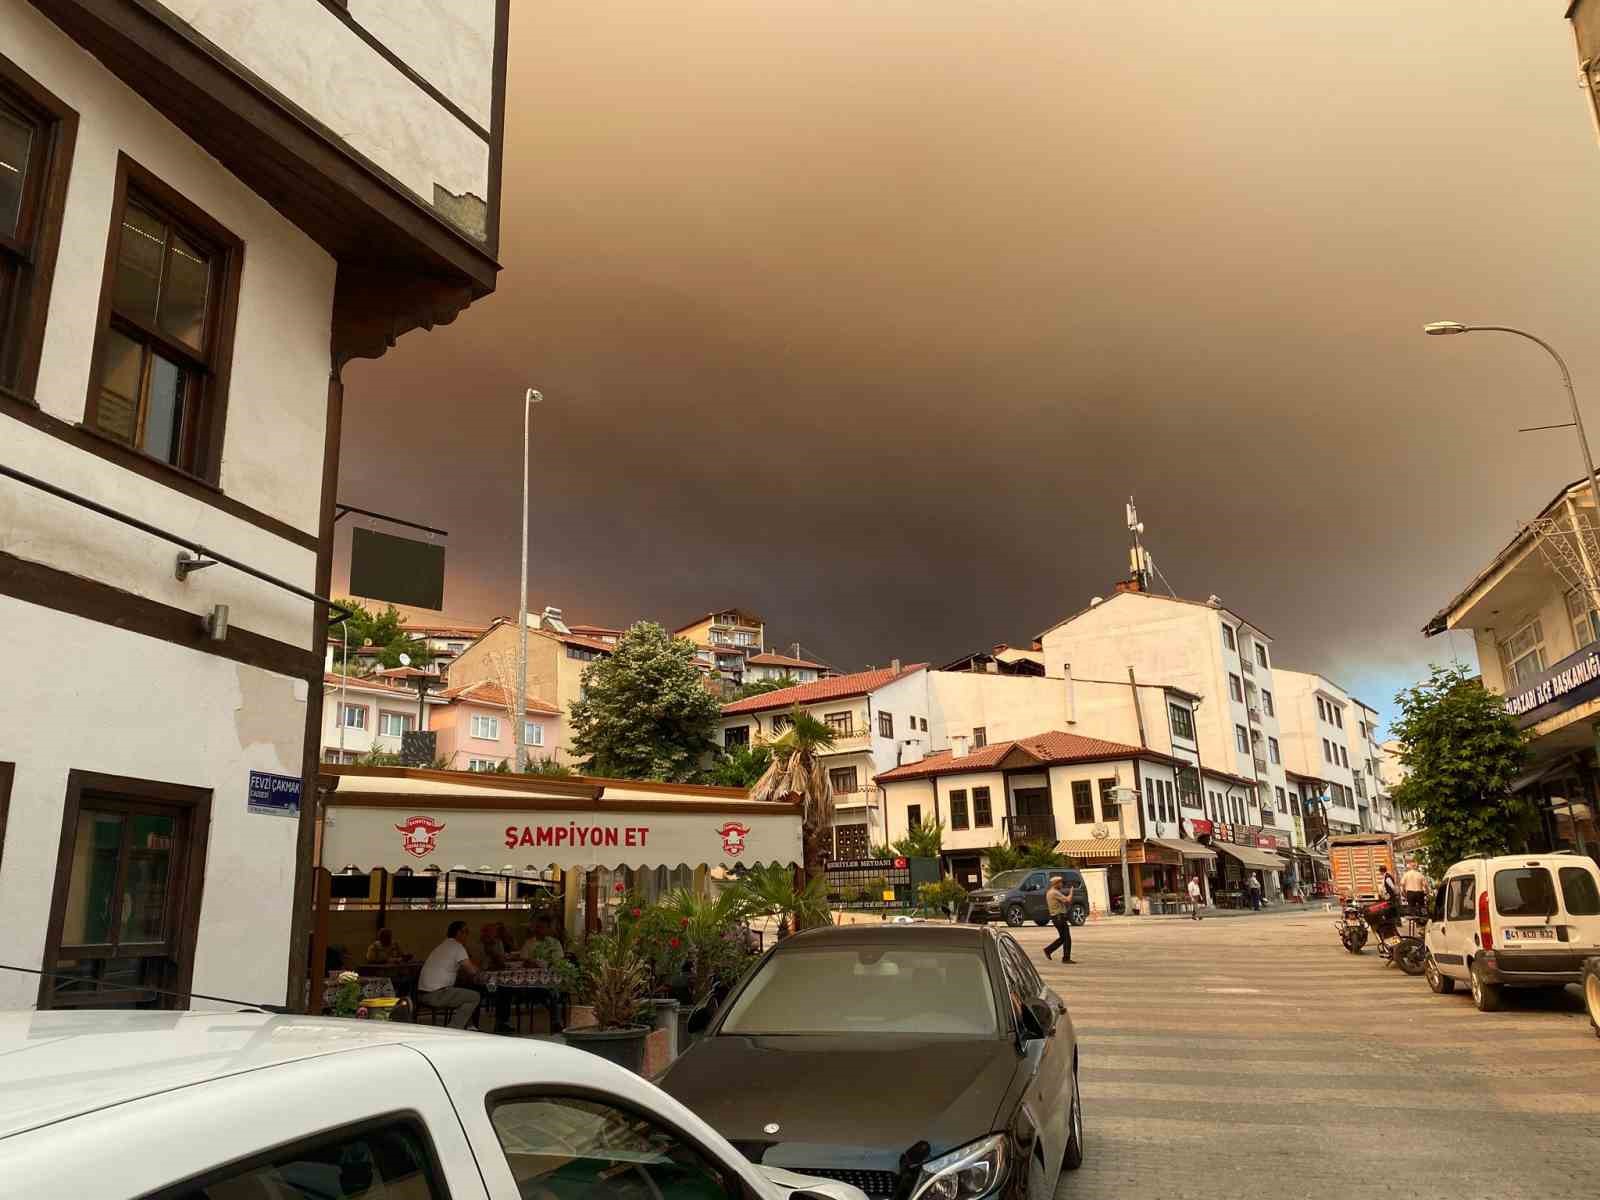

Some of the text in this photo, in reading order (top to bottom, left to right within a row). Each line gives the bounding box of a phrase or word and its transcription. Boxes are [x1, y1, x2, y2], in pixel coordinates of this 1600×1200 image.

[251, 775, 299, 793] FEVZİ ÇAKMAK
[505, 821, 649, 849] ŞAMPİYON ET
